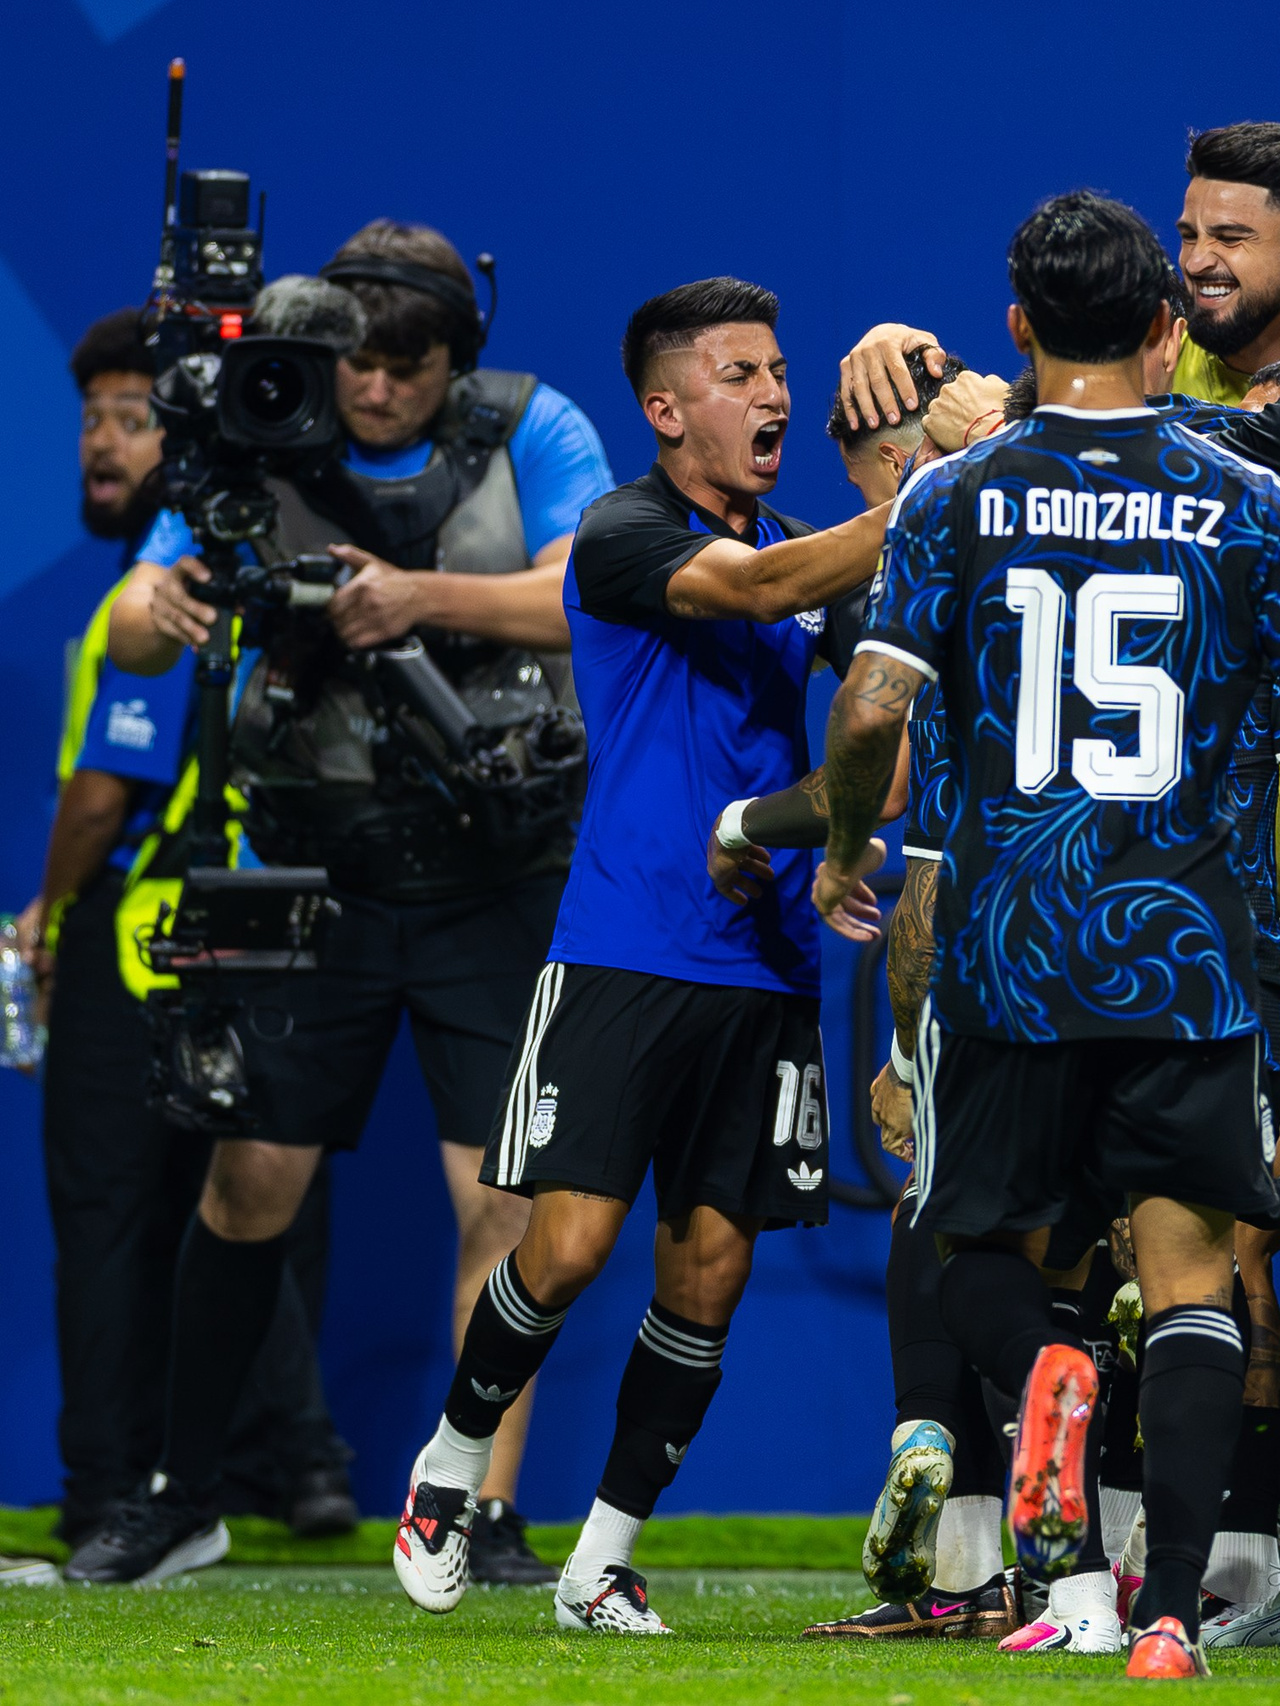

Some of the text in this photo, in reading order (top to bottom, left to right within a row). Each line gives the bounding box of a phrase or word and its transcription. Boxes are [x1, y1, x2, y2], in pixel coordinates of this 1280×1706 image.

[979, 487, 1226, 547] N. GONZALEZ
[856, 668, 909, 714] 22
[1005, 567, 1185, 802] 15
[773, 1060, 822, 1150] 16
